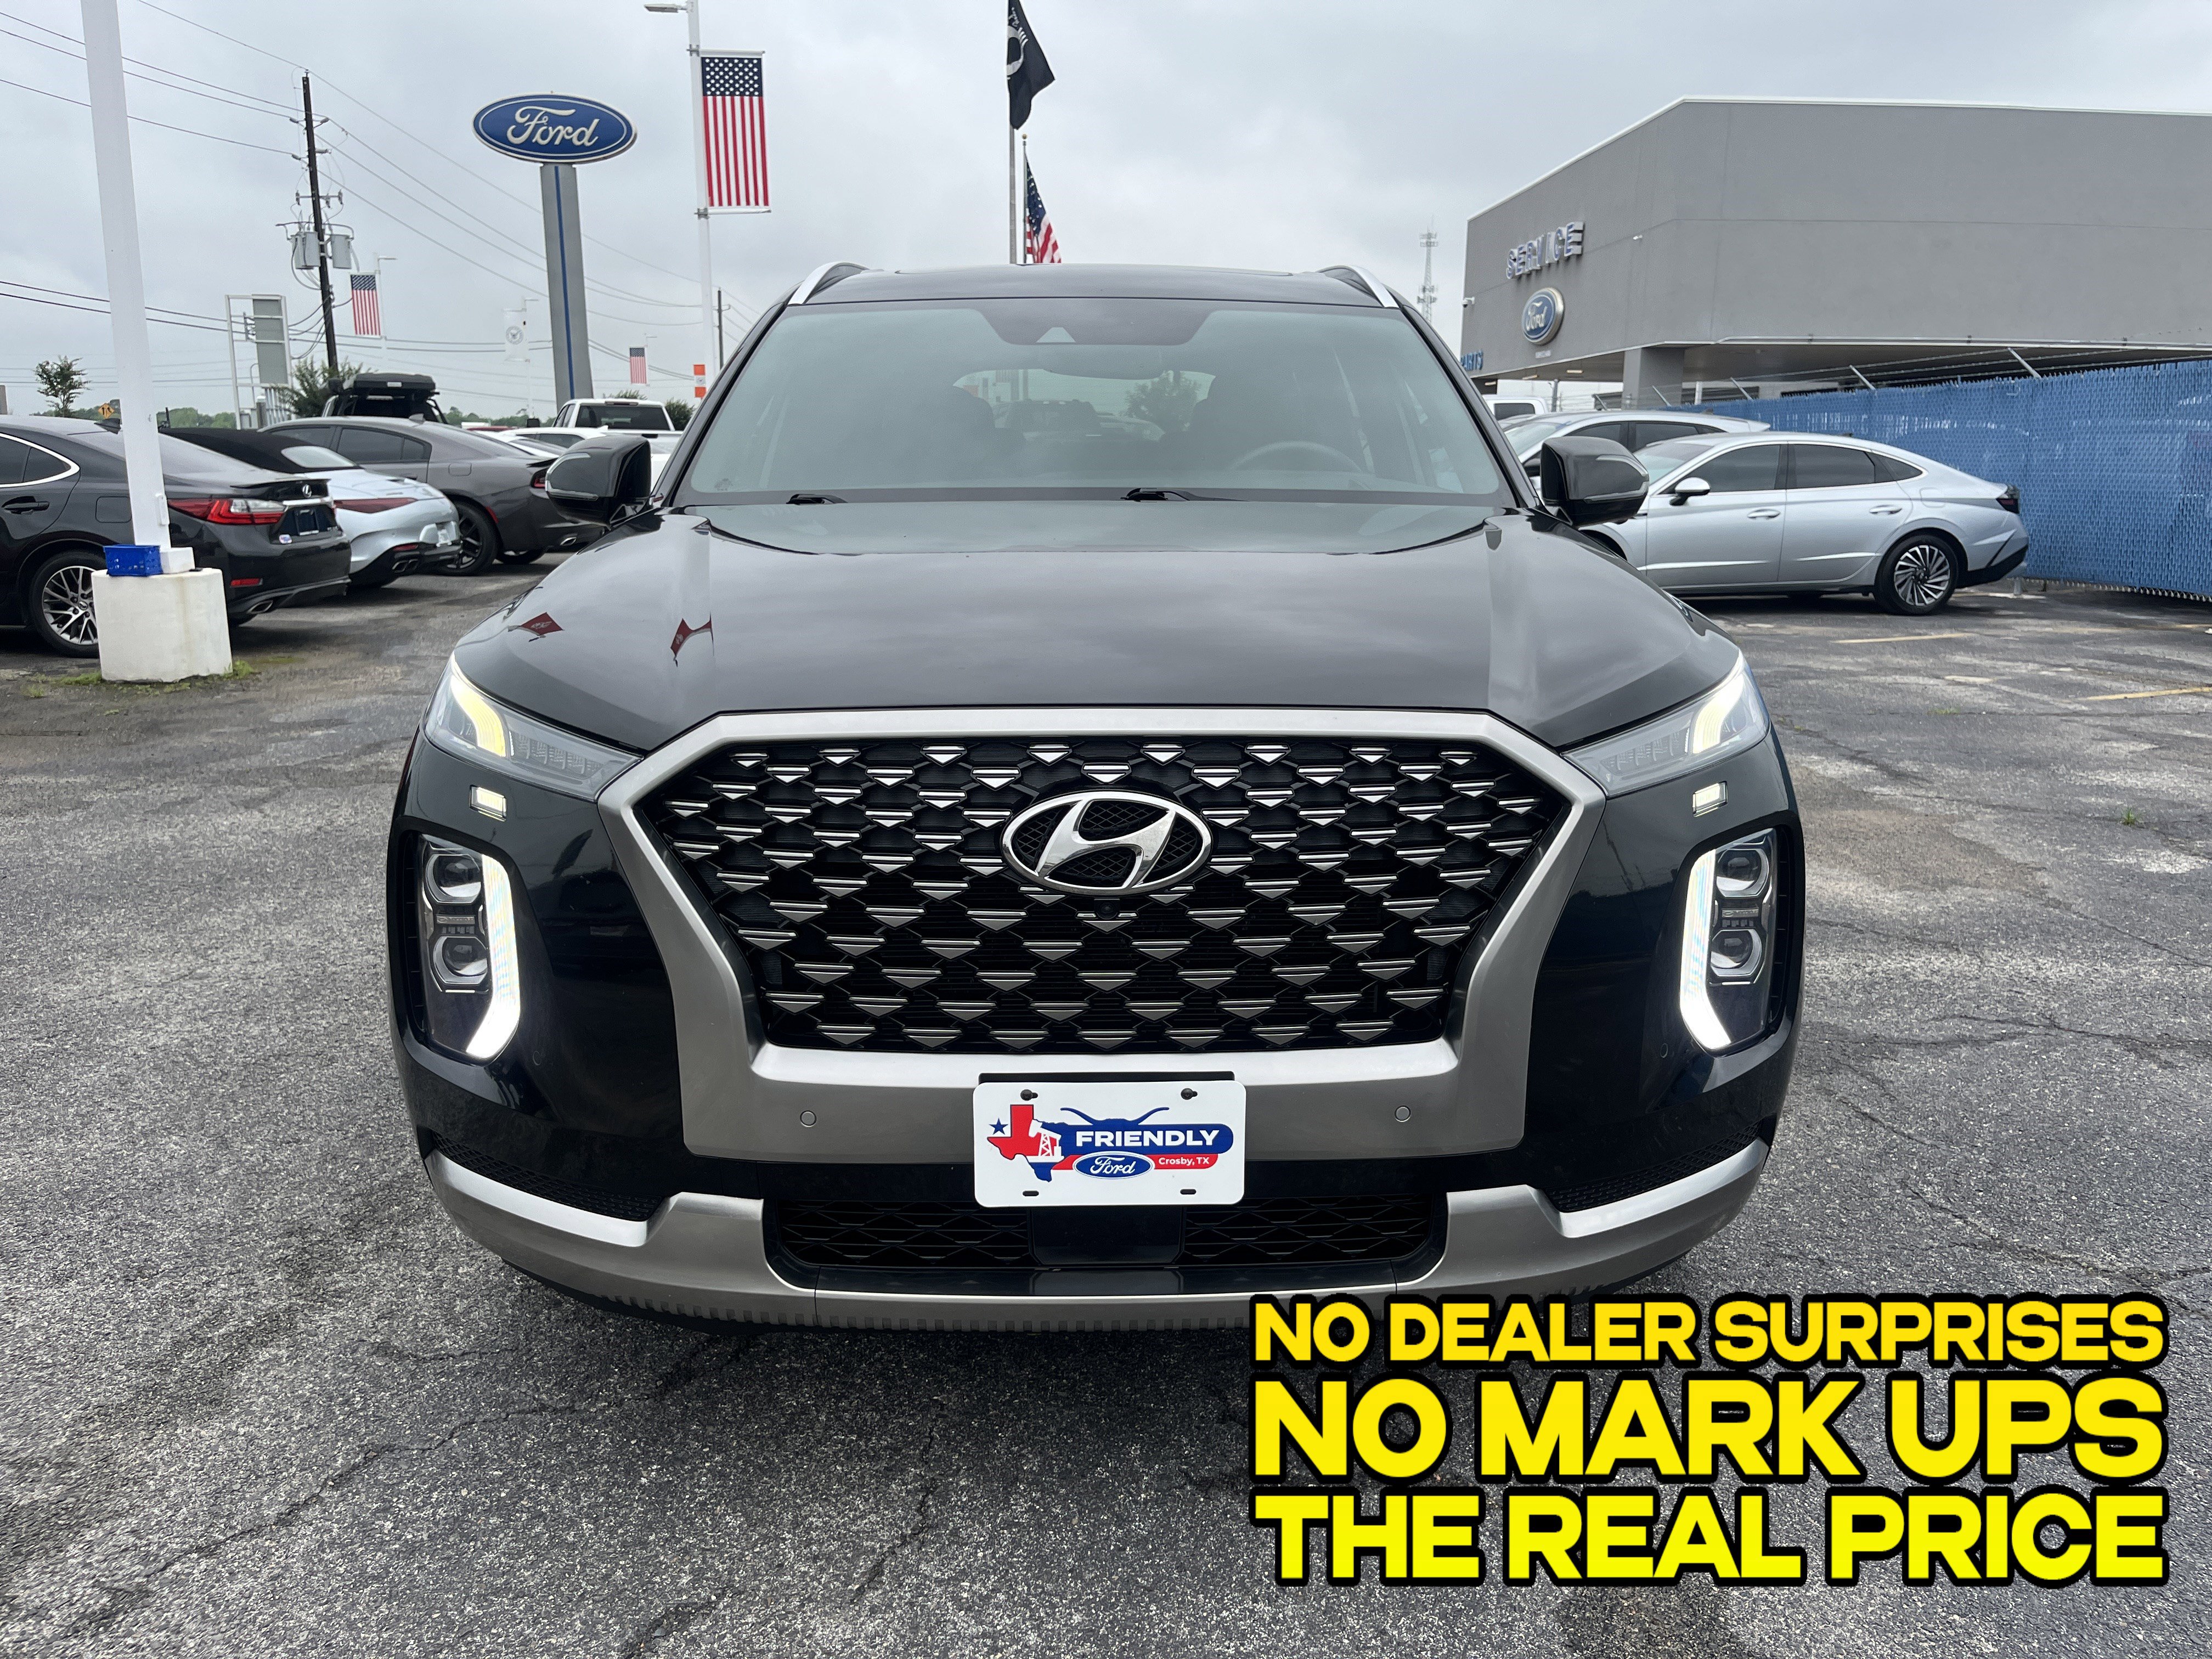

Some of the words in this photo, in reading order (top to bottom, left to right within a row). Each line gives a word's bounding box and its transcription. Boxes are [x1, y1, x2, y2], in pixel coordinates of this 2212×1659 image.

[507, 106, 600, 146] Ford
[1506, 222, 1584, 279] SERVICE
[1526, 302, 1548, 331] Ford
[1076, 1130, 1220, 1147] FRIENDLY
[1090, 1156, 1136, 1175] Ford
[1158, 1157, 1195, 1166] Crosby,
